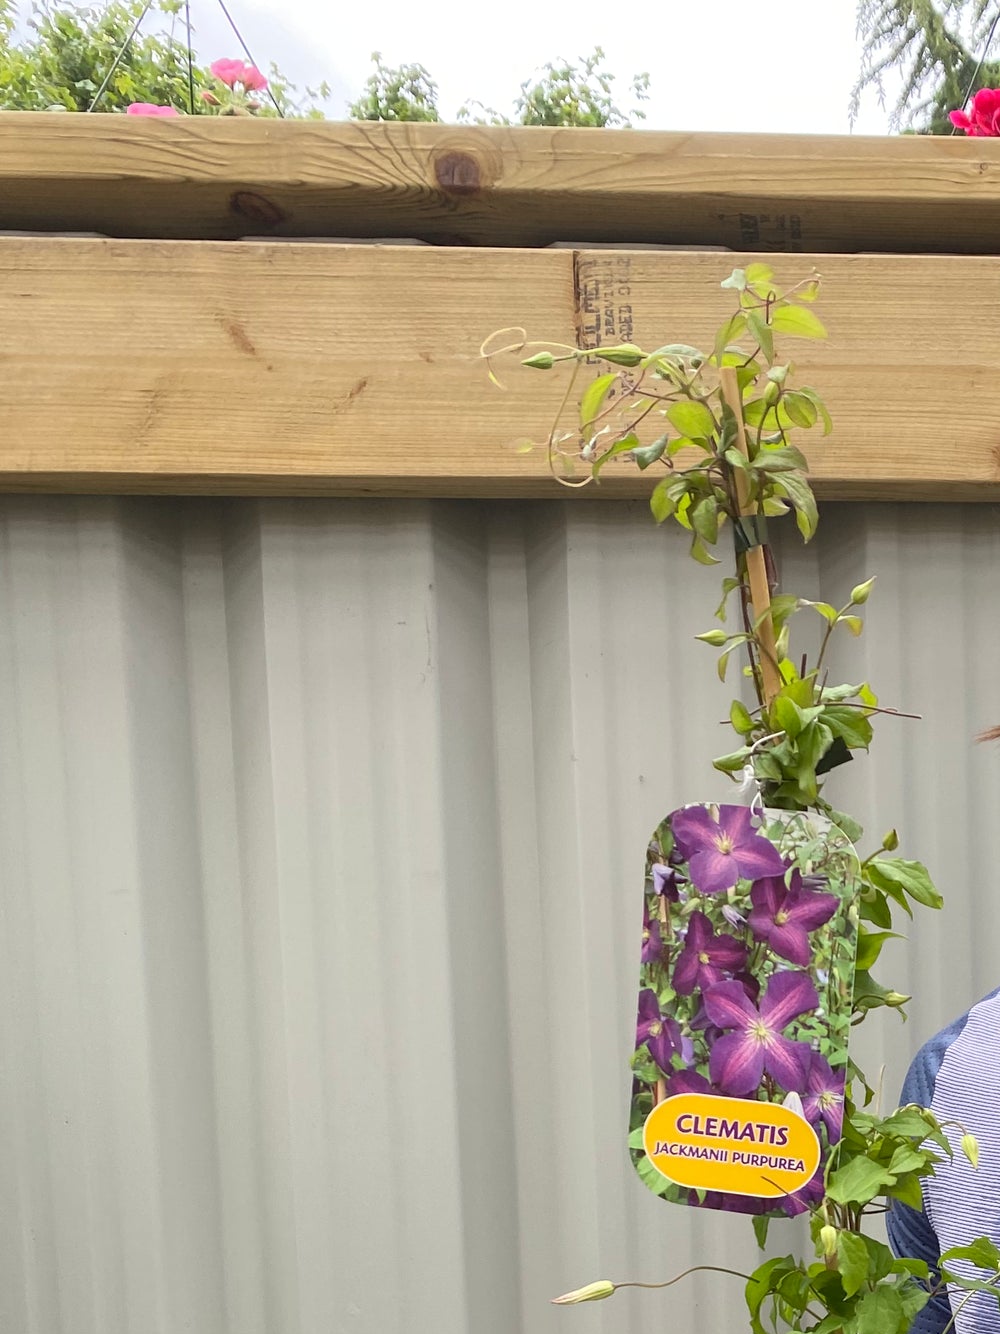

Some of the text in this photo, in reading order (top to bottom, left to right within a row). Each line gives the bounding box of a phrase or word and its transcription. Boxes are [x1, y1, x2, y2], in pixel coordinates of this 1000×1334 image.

[676, 1114, 789, 1146] CLEMATIS
[653, 1141, 805, 1172] JACKMANII PURPUREA
